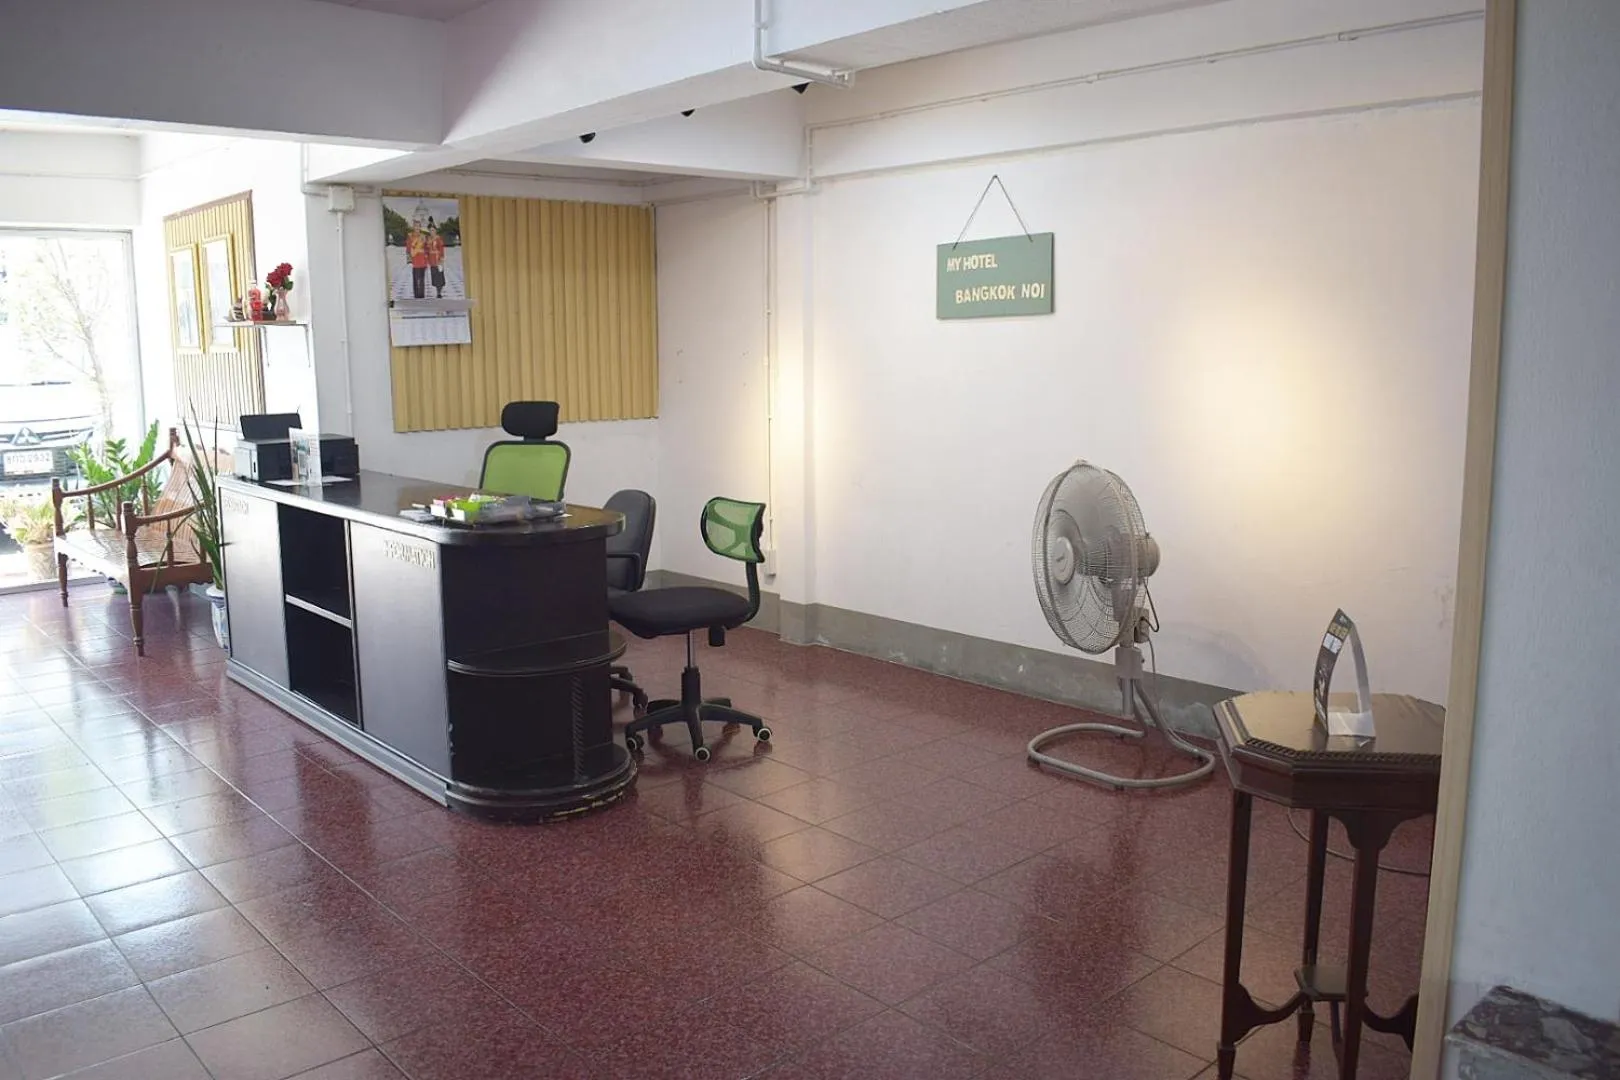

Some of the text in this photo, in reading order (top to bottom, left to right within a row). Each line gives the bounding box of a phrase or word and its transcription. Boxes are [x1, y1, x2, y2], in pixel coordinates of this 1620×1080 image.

[946, 254, 998, 272] MY HOTEL
[955, 282, 1046, 304] BANGKOK NOI
